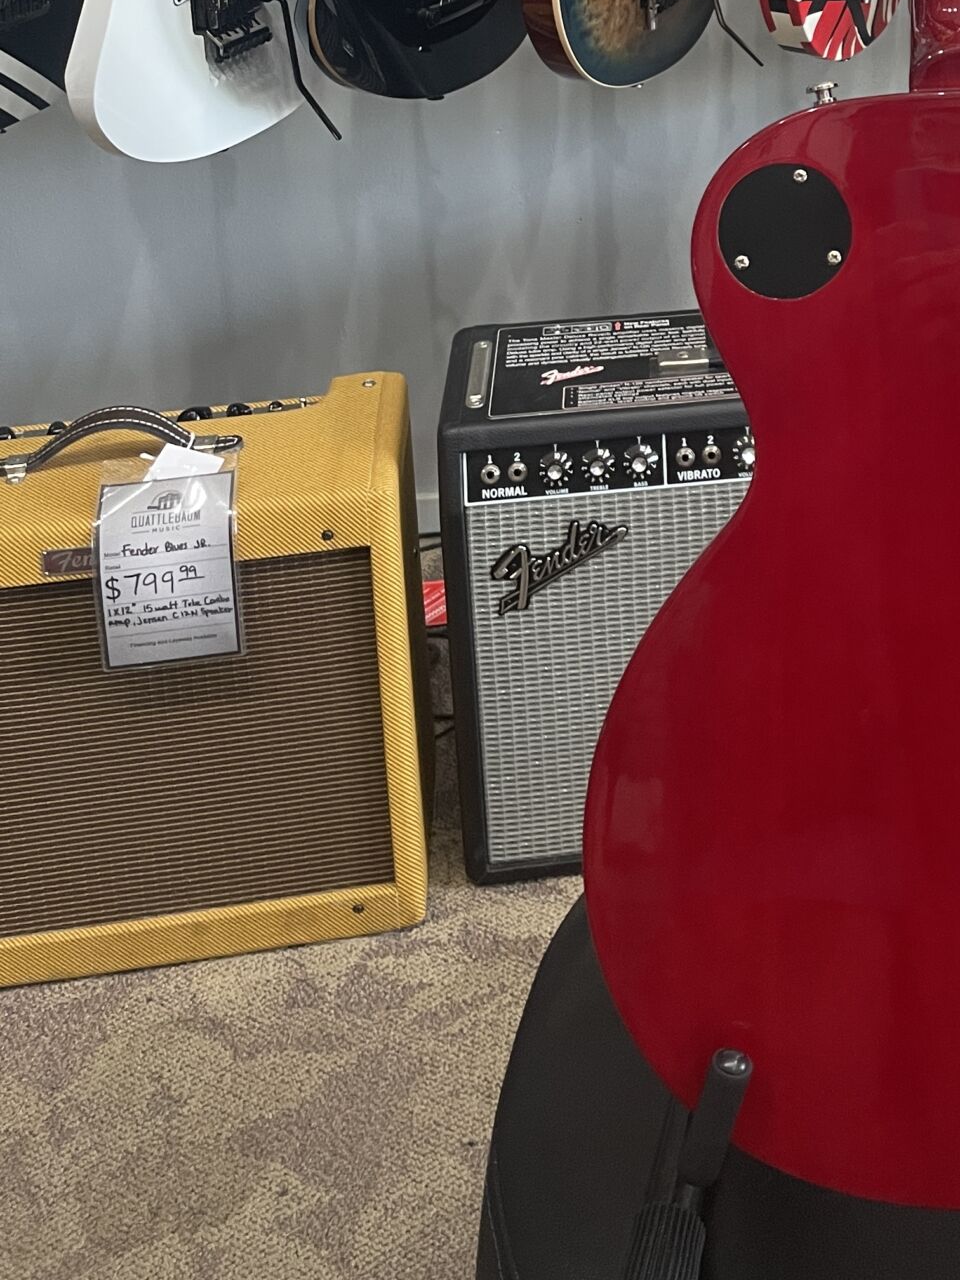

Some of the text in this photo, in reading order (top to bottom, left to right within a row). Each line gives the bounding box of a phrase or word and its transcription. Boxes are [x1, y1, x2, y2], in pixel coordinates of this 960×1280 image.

[540, 366, 605, 385] Fender
[682, 435, 714, 447] 1 2
[487, 452, 521, 464] 1 2
[677, 468, 721, 481] VIBRATO
[482, 485, 528, 500] NORMAL
[545, 488, 569, 496] VOLUME
[131, 511, 201, 529] QUATTLEBAUM
[152, 525, 181, 533] MUSIC
[121, 543, 159, 557] Fender
[165, 541, 188, 553] Blues
[51, 551, 94, 573] Fen
[491, 520, 629, 616] Fender
[137, 616, 168, 627] Jensen
